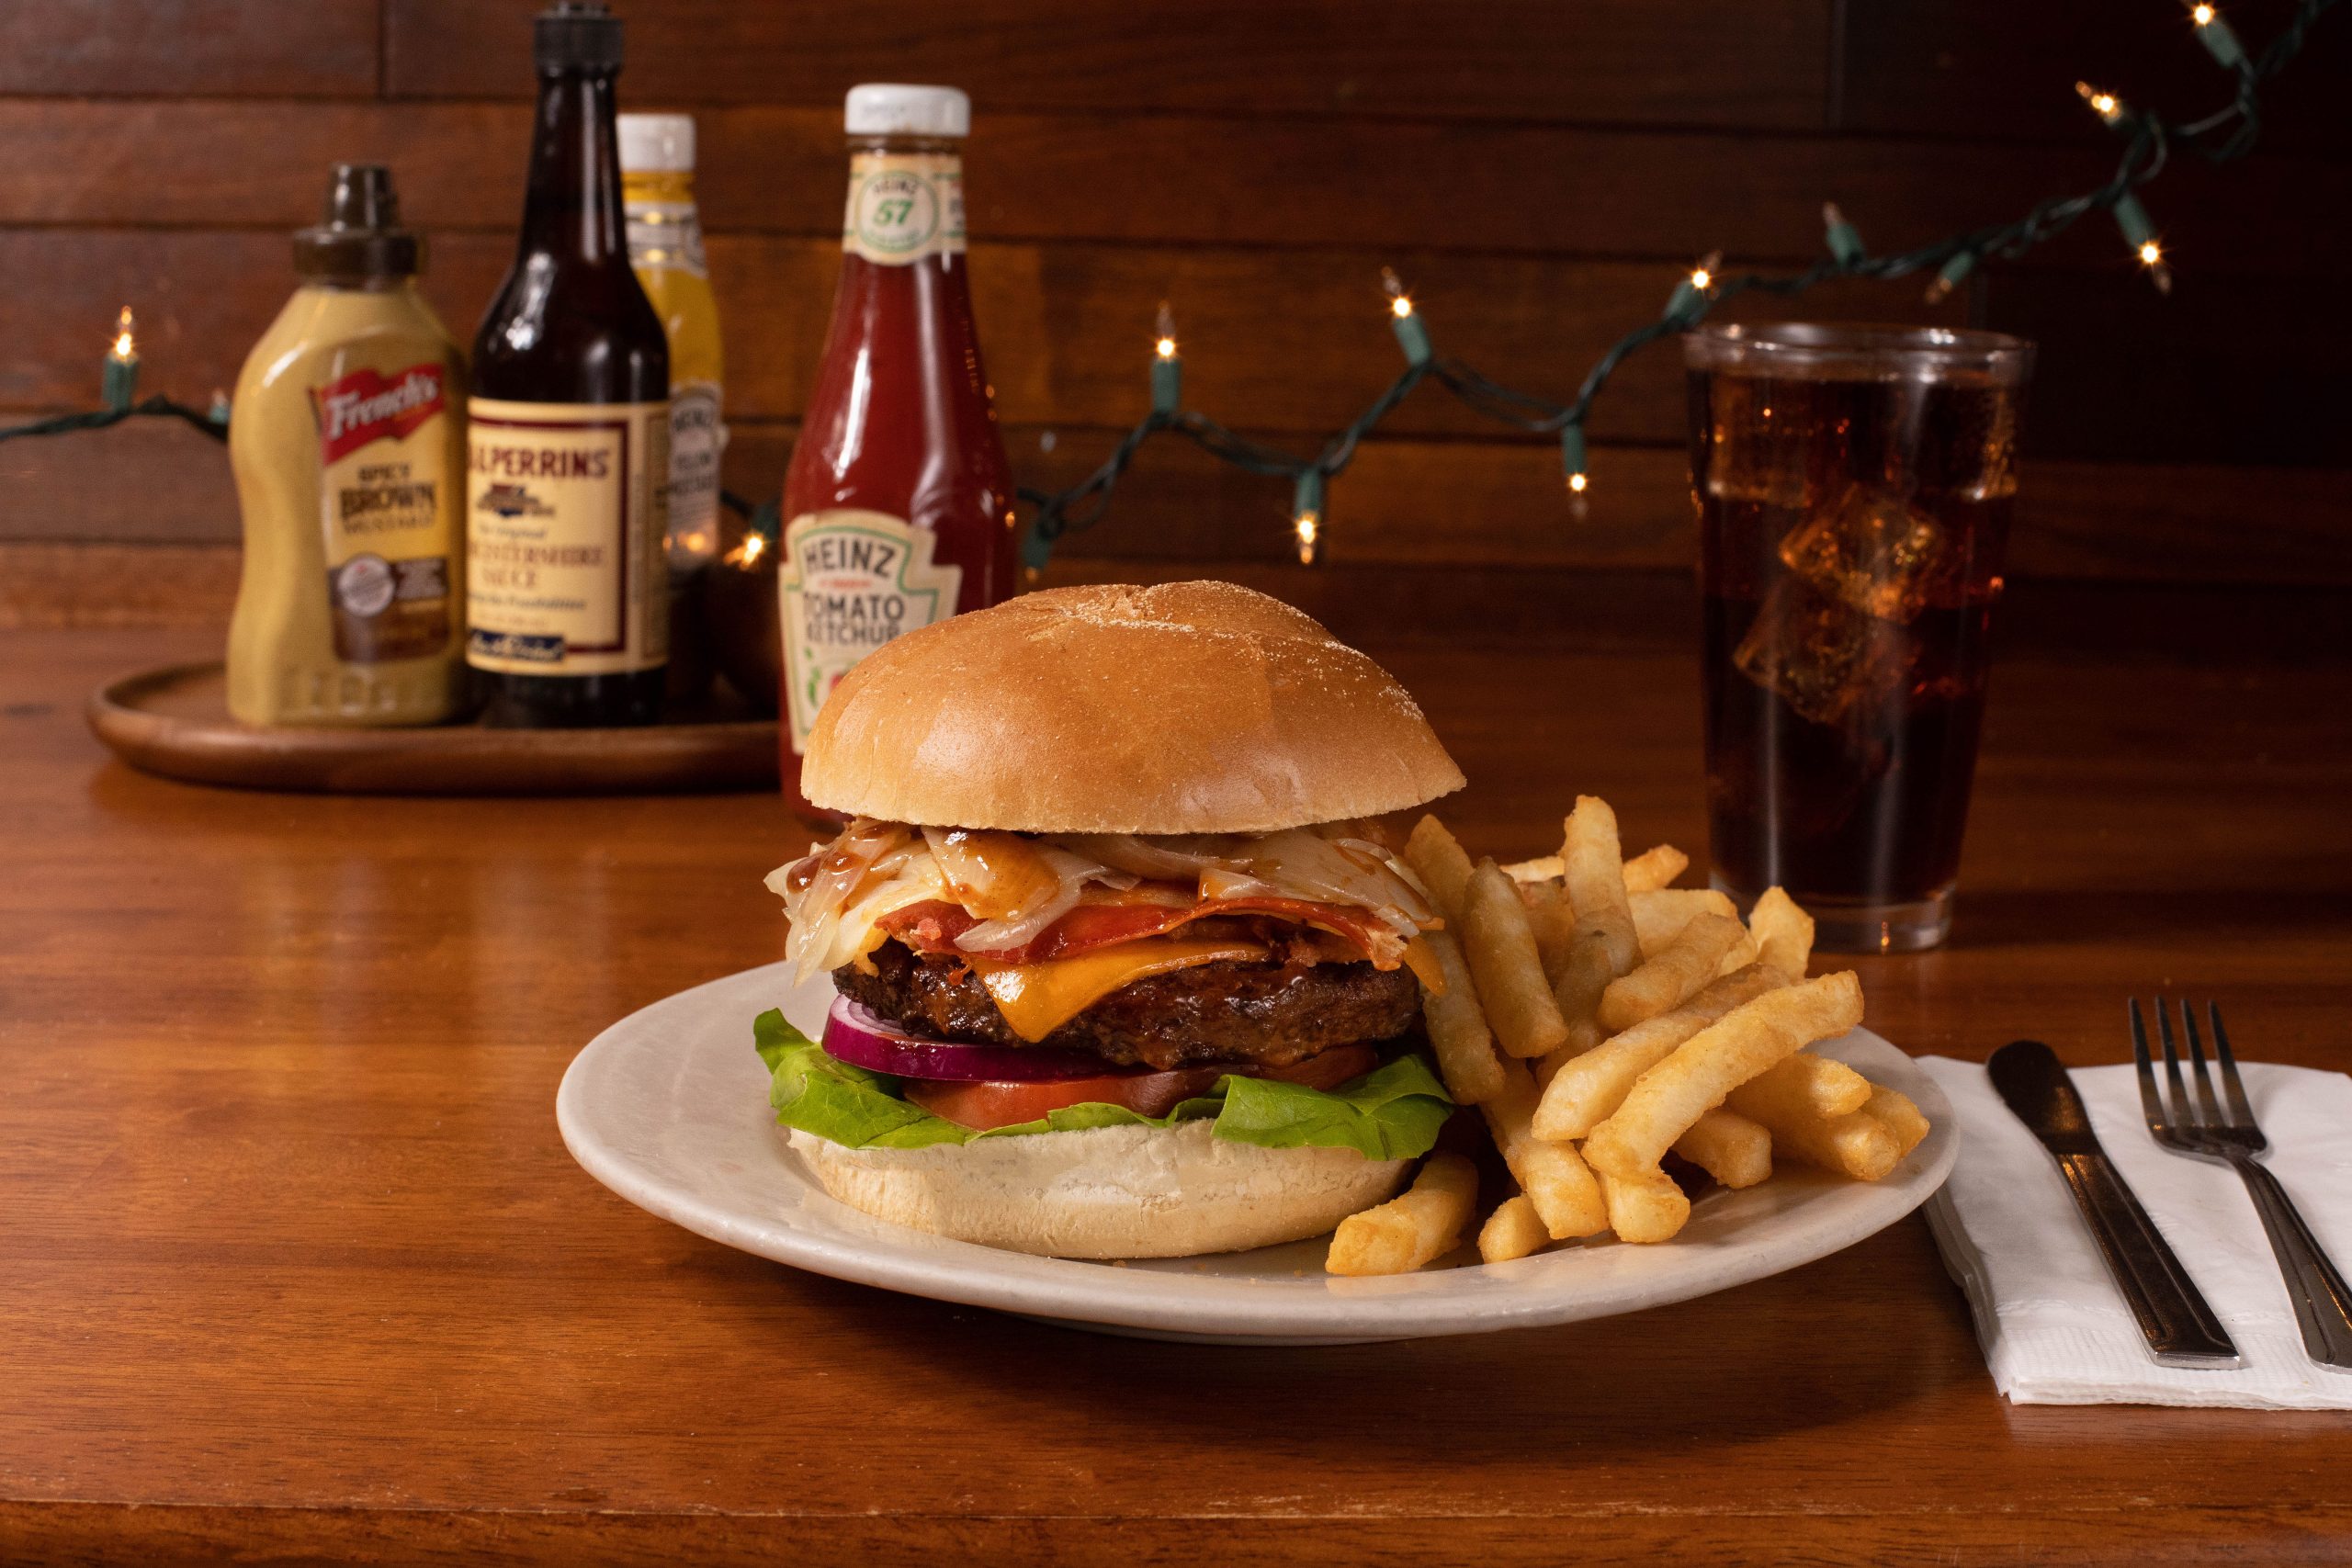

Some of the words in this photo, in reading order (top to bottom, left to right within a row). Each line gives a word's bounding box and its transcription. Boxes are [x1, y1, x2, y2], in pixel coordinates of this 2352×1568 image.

[874, 179, 918, 195] HEINZ
[872, 199, 914, 226] 57
[326, 373, 438, 441] French's
[357, 464, 410, 482] SPICY
[492, 446, 610, 479] PERRINS
[340, 482, 436, 520] BROWN
[804, 538, 896, 578] HEINZ
[804, 592, 905, 621] TOMATO
